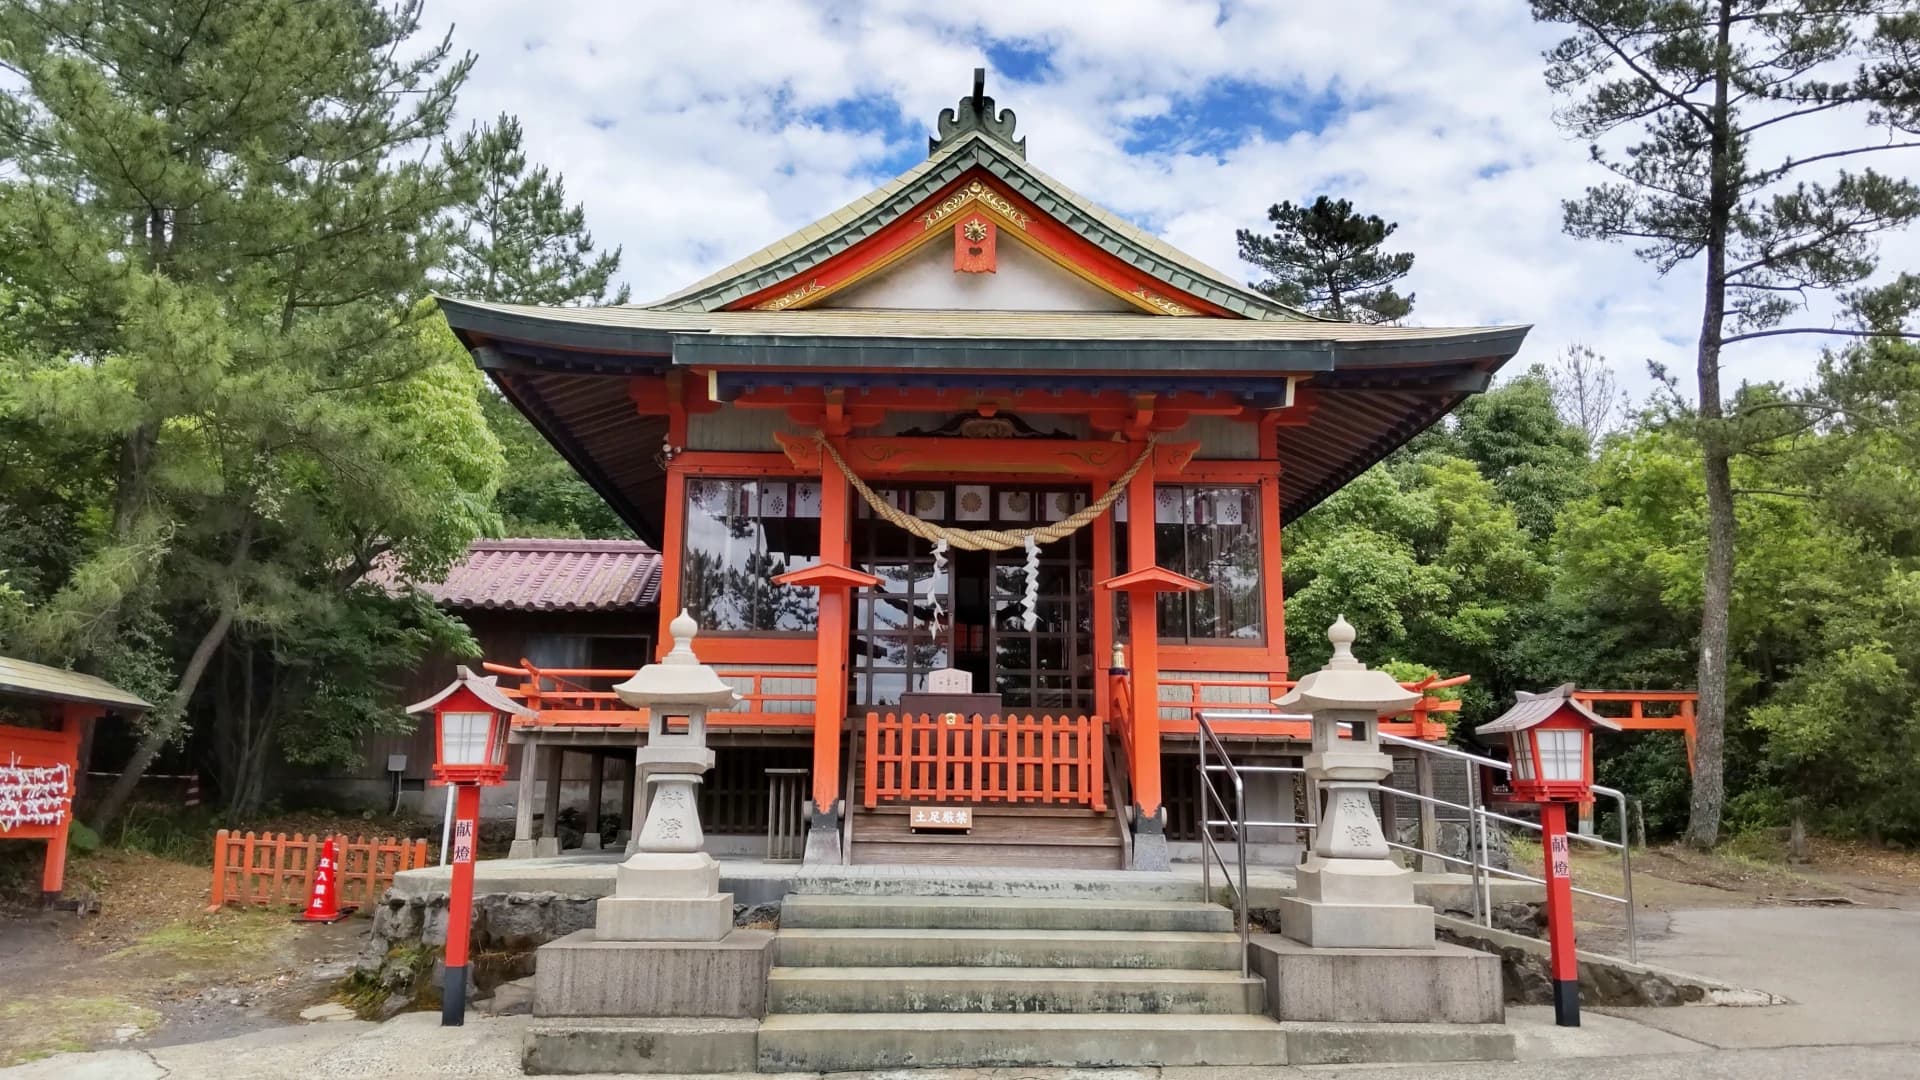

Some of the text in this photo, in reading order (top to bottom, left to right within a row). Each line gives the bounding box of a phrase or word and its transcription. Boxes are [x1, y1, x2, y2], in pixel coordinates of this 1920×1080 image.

[455, 821, 472, 861] 献燈
[1552, 836, 1569, 876] 献燈
[312, 857, 330, 908] 立入禁止
